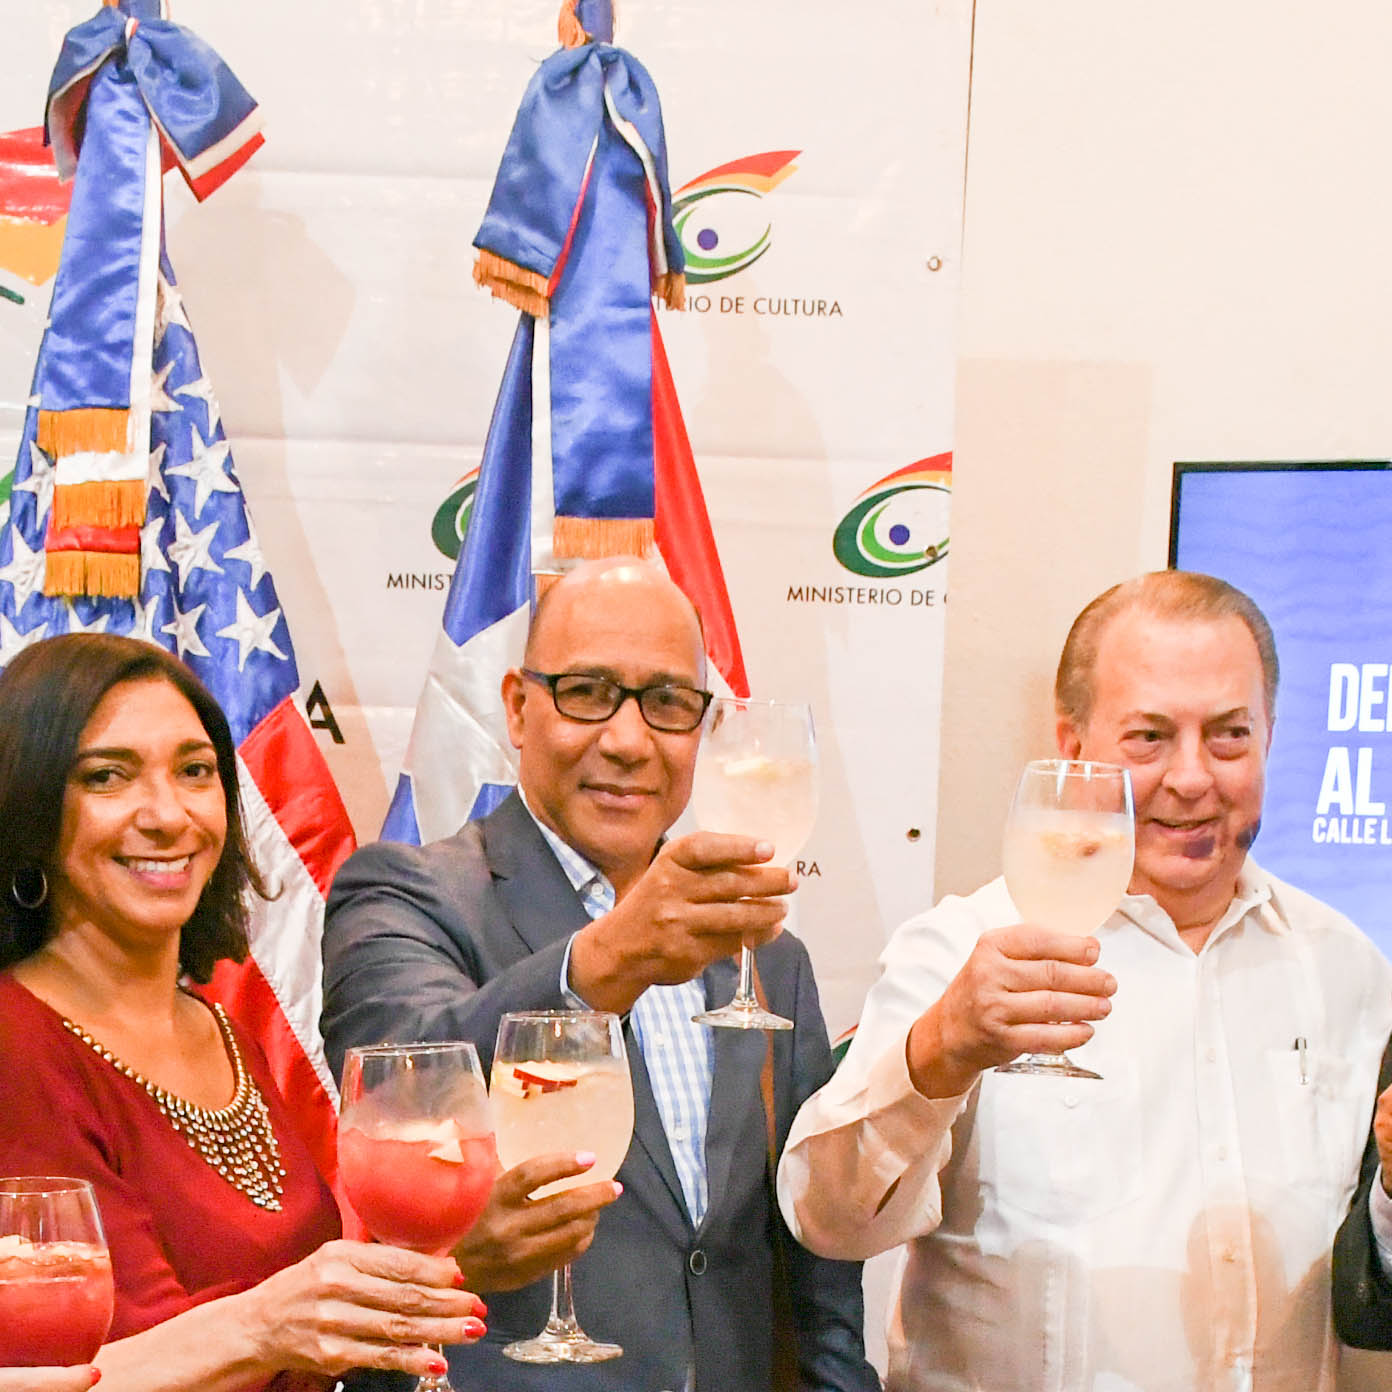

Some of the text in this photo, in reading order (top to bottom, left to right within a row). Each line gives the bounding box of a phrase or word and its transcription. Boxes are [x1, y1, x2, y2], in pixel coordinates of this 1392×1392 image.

[720, 296, 745, 314] DE
[753, 297, 844, 317] CULTURA
[386, 572, 455, 591] MINIST
[786, 585, 903, 606] MINISTERIO
[911, 589, 935, 606] DE
[1316, 746, 1386, 816] AL
[1312, 817, 1378, 845] CALLE
